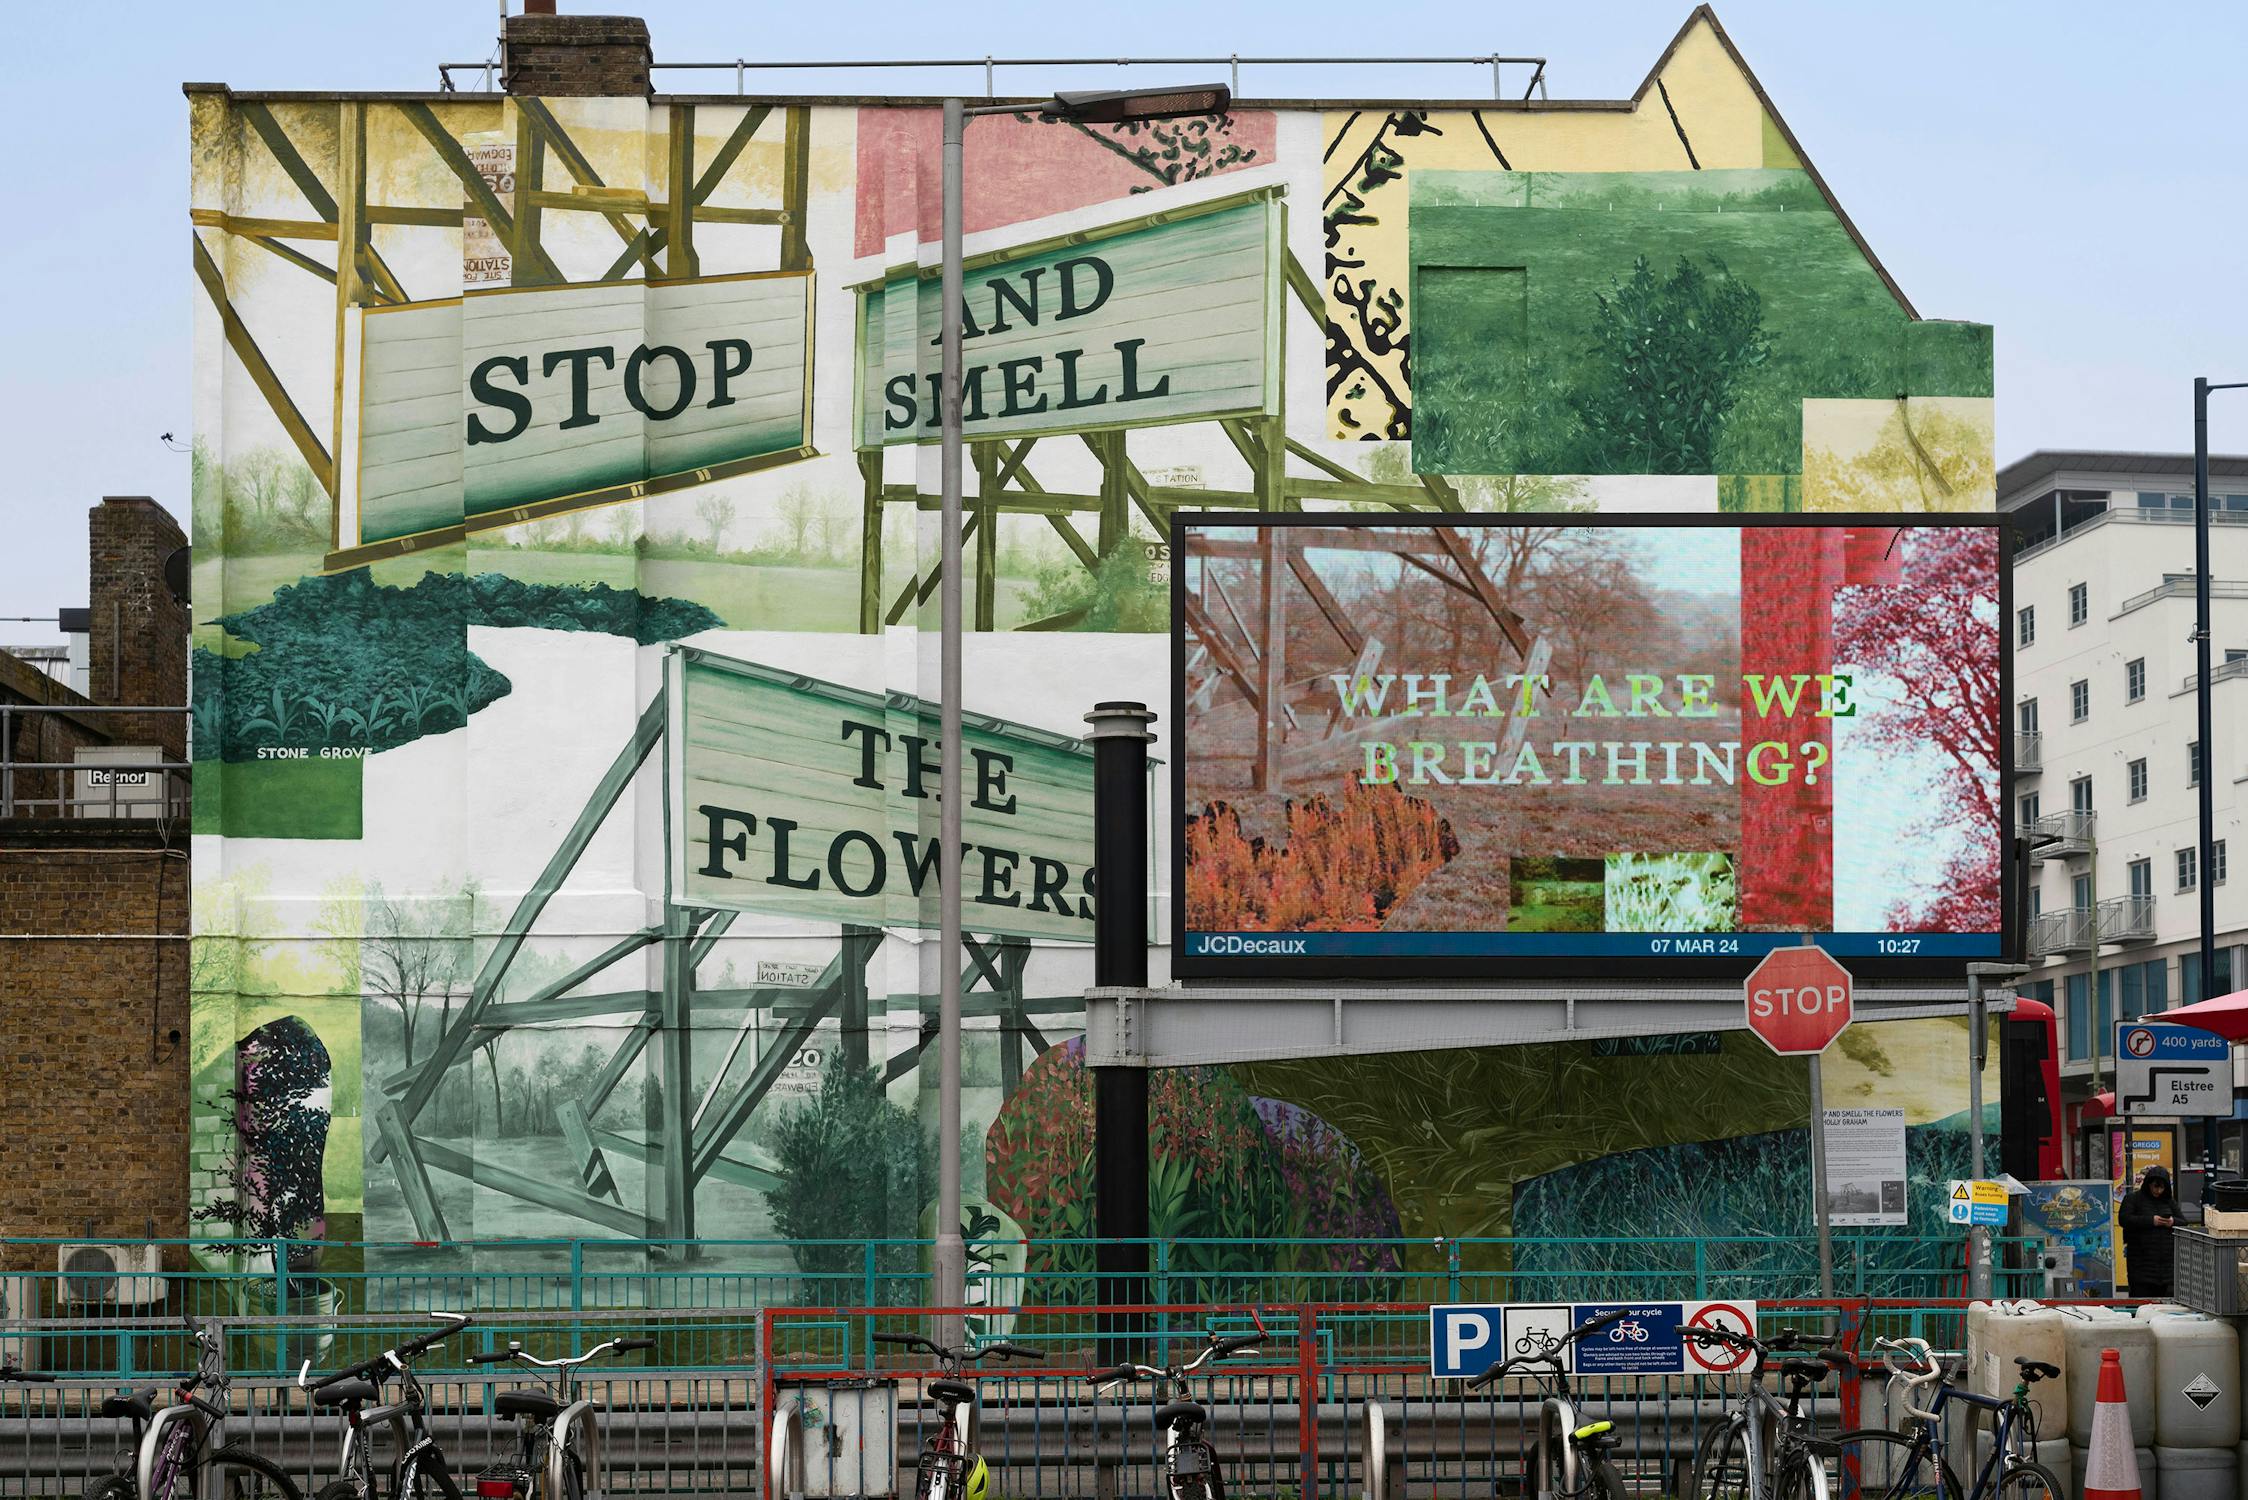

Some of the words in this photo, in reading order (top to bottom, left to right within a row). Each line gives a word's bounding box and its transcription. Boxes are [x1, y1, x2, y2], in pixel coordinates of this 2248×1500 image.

[931, 256, 1114, 346] AND
[467, 338, 752, 446] STOP
[885, 338, 1169, 431] SMELL
[1330, 673, 1549, 718] WHAT
[1572, 673, 1716, 718] ARE
[1742, 674, 1857, 718] WE
[257, 747, 309, 759] STONE
[320, 747, 374, 760] GROVE
[841, 720, 1016, 815] THE
[1359, 740, 1827, 786] BREATHING?
[1198, 936, 1306, 954] JCDecaux
[1651, 939, 1672, 953] 07
[1675, 939, 1714, 953] MAR
[1719, 939, 1739, 953] 24
[1877, 939, 1921, 953] 10:27
[1753, 985, 1845, 1017] STOP
[2162, 1037, 2187, 1048] 400
[2191, 1037, 2222, 1049] yards
[2171, 1081, 2214, 1091] Elstree
[2172, 1094, 2188, 1105] A5
[1829, 1110, 1840, 1118] AND
[1595, 1309, 1617, 1317] Secur
[1642, 1308, 1662, 1317] cycle
[1447, 1314, 1490, 1369] P
